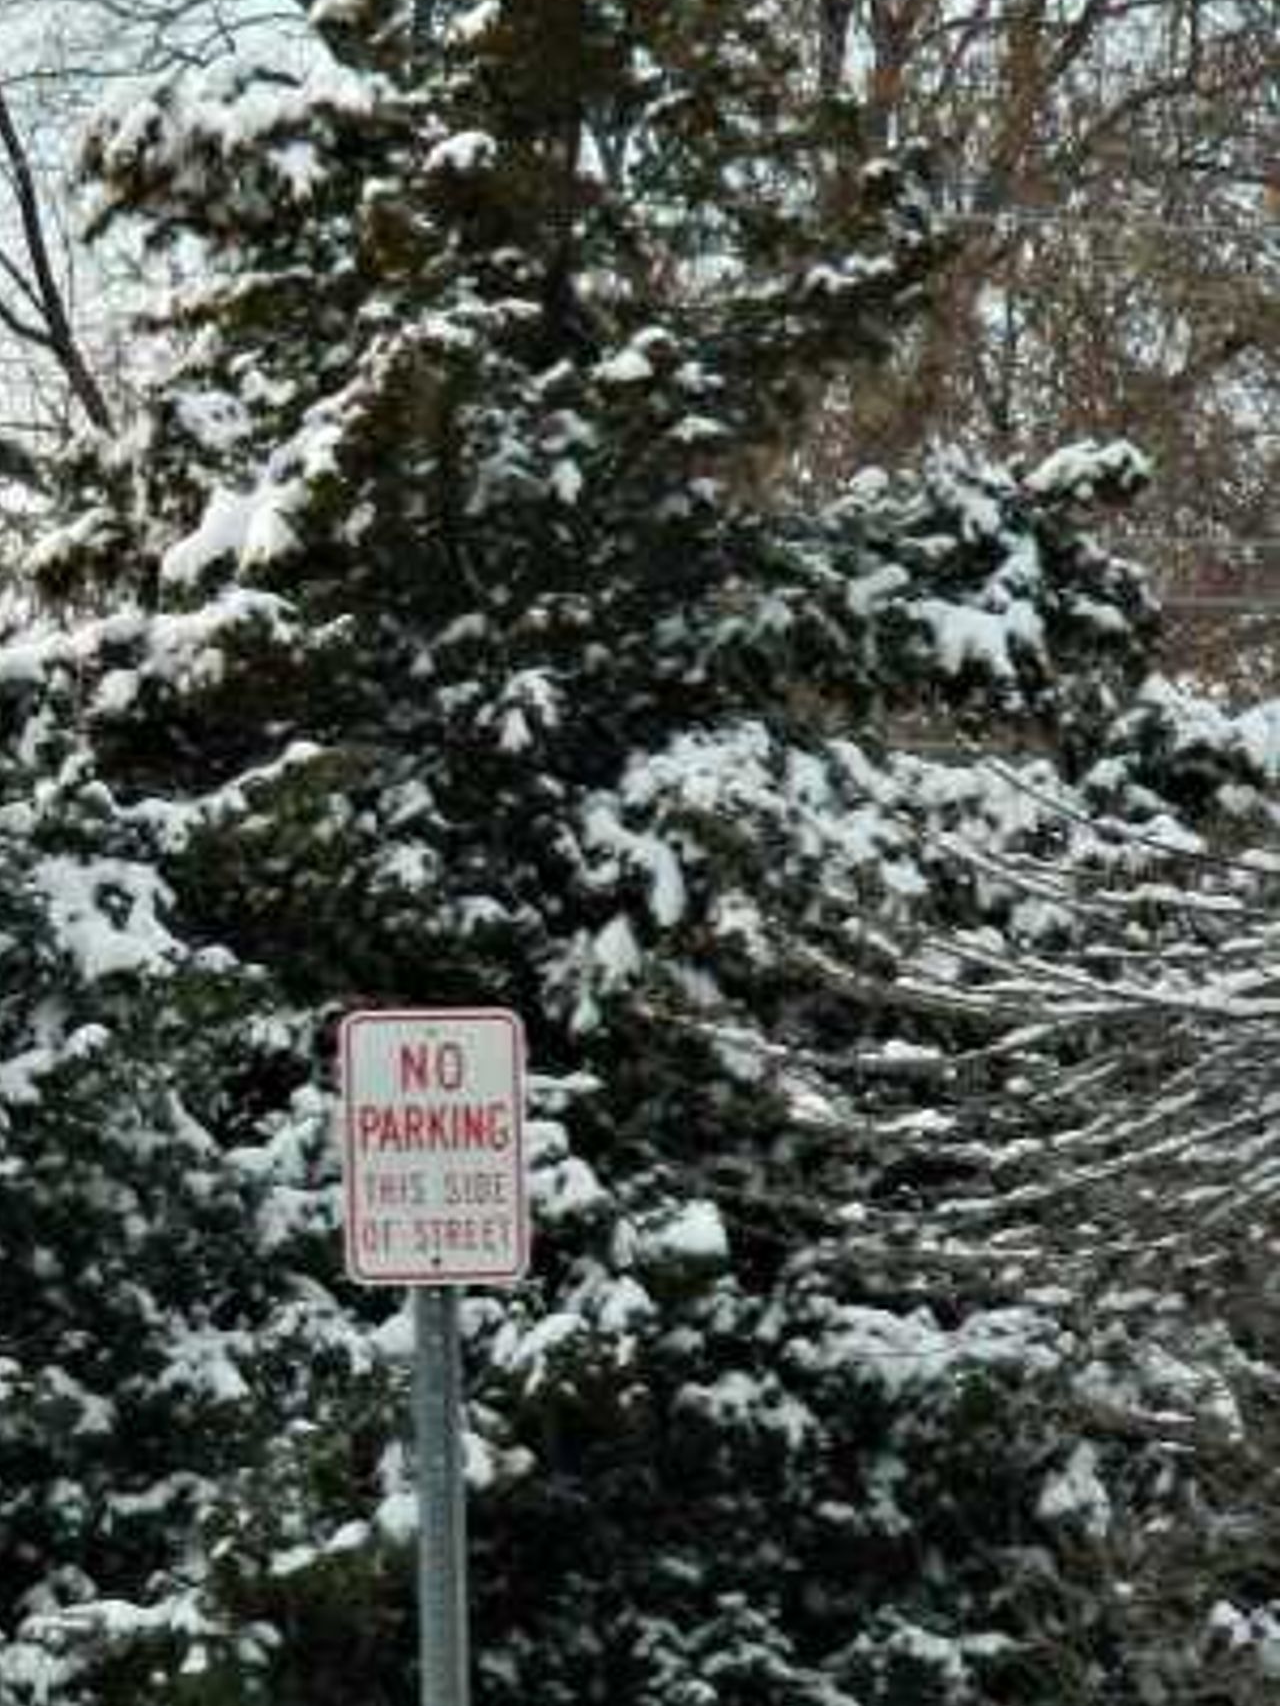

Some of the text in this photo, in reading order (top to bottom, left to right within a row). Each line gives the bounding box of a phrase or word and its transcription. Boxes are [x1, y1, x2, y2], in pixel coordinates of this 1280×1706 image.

[400, 1043, 464, 1090] NO
[360, 1104, 510, 1152] PARKING
[362, 1172, 507, 1204] THIS SIDE
[363, 1220, 510, 1254] OF STREET
